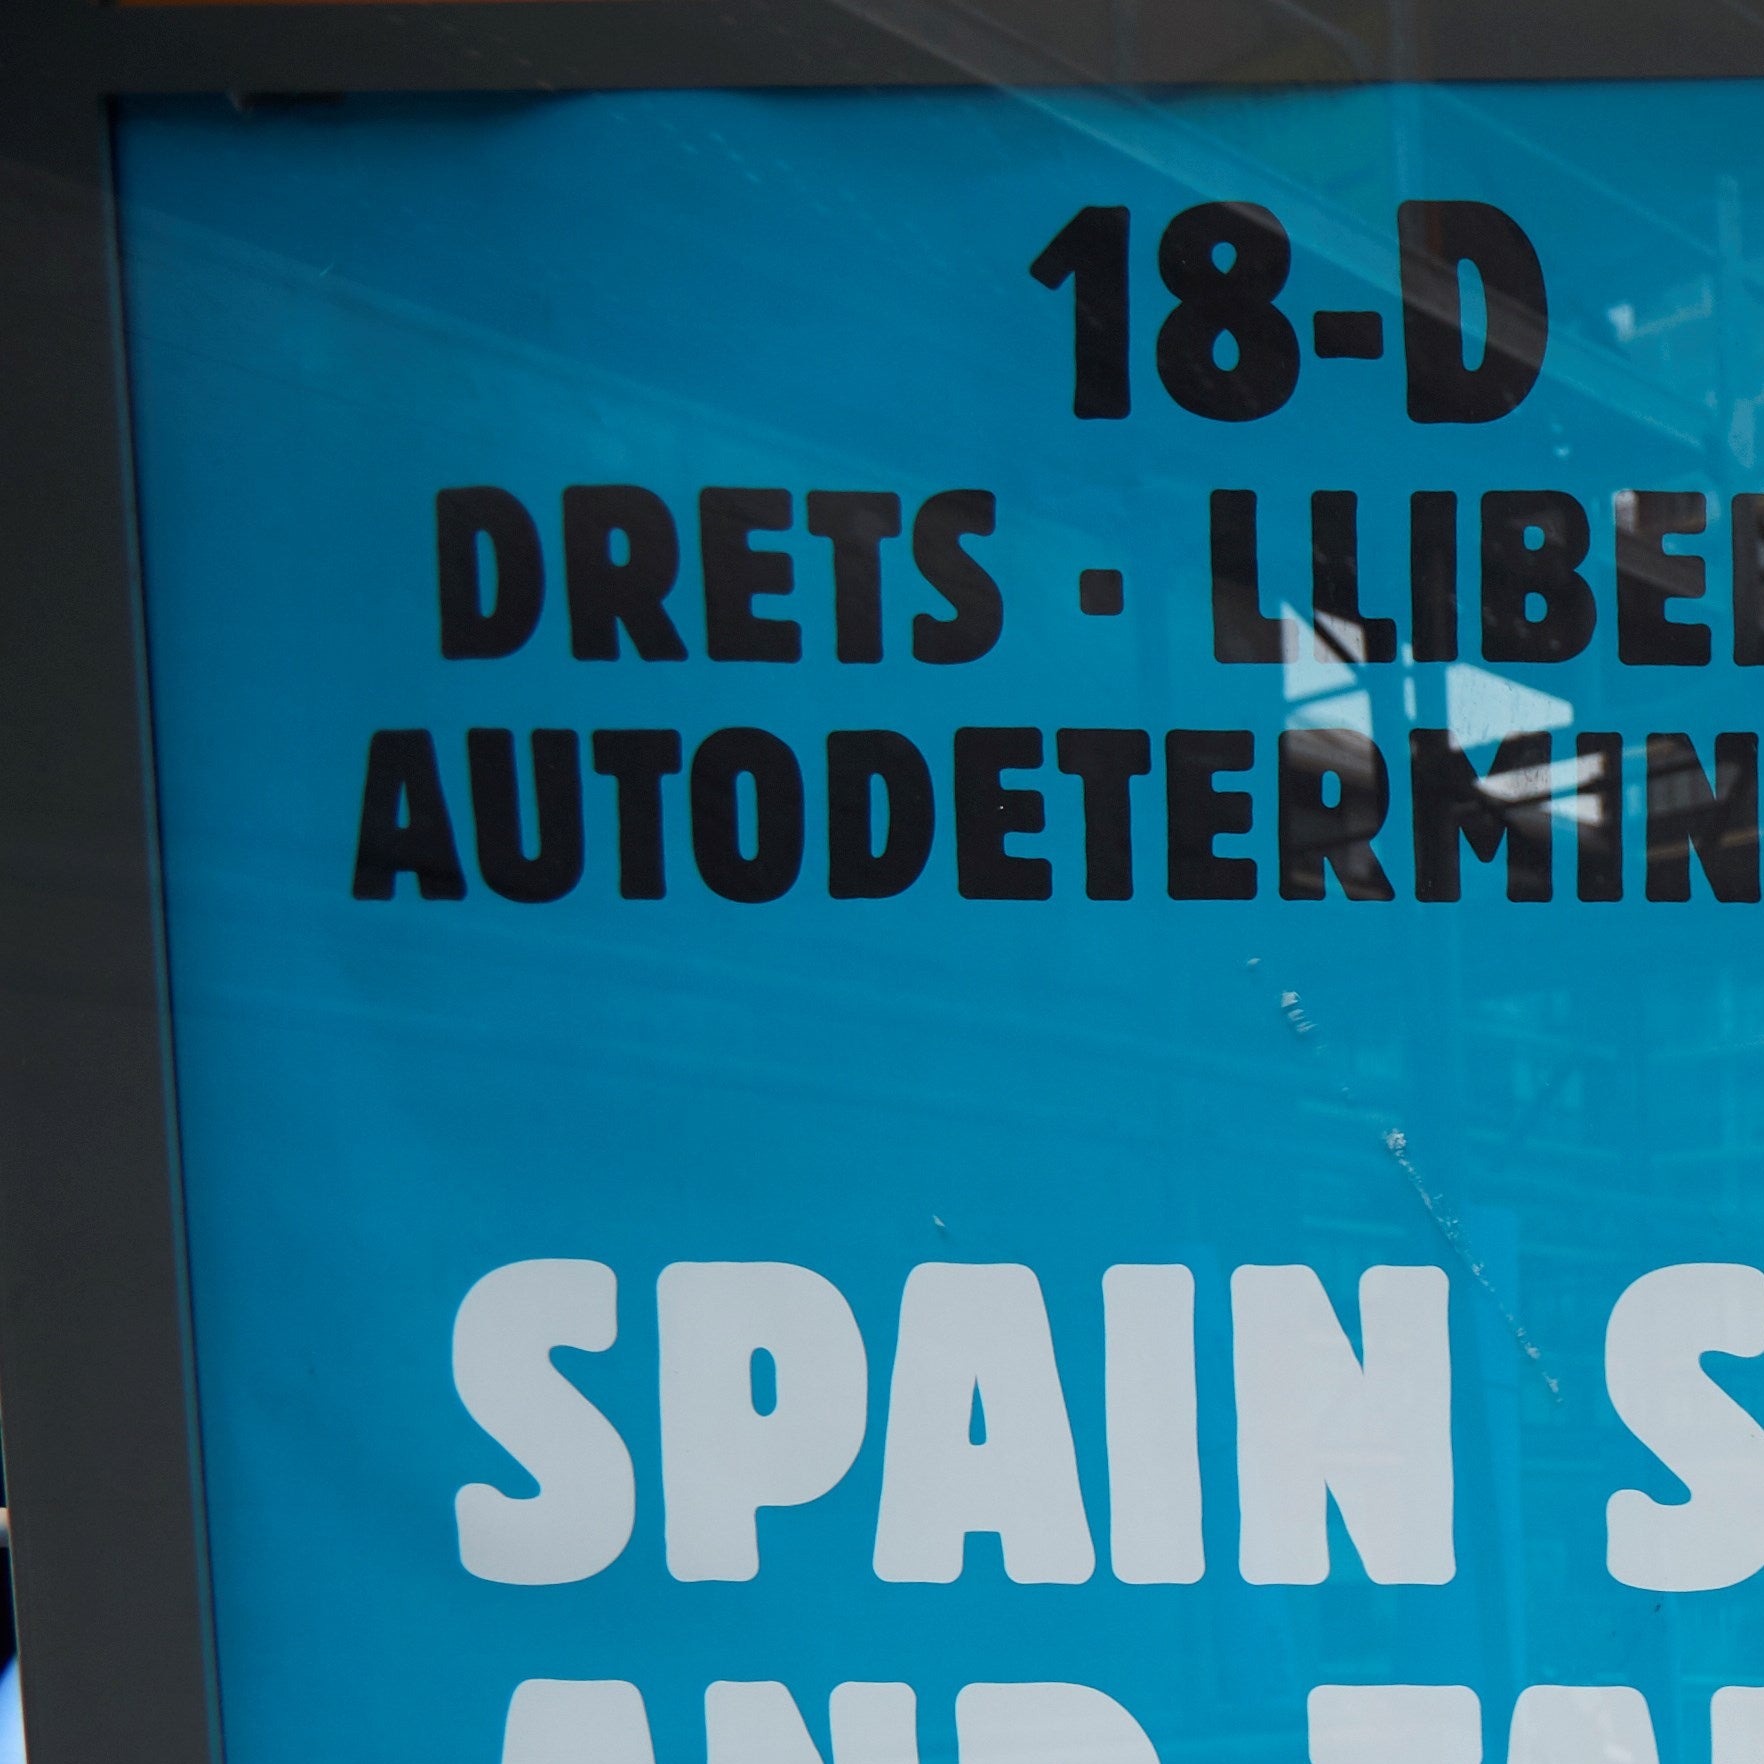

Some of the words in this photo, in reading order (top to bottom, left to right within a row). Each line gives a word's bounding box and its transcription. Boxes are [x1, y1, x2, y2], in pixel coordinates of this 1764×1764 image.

[1027, 199, 1549, 425] 18-D
[432, 483, 1004, 666] DRETS
[452, 1258, 1457, 1587] SPAIN
